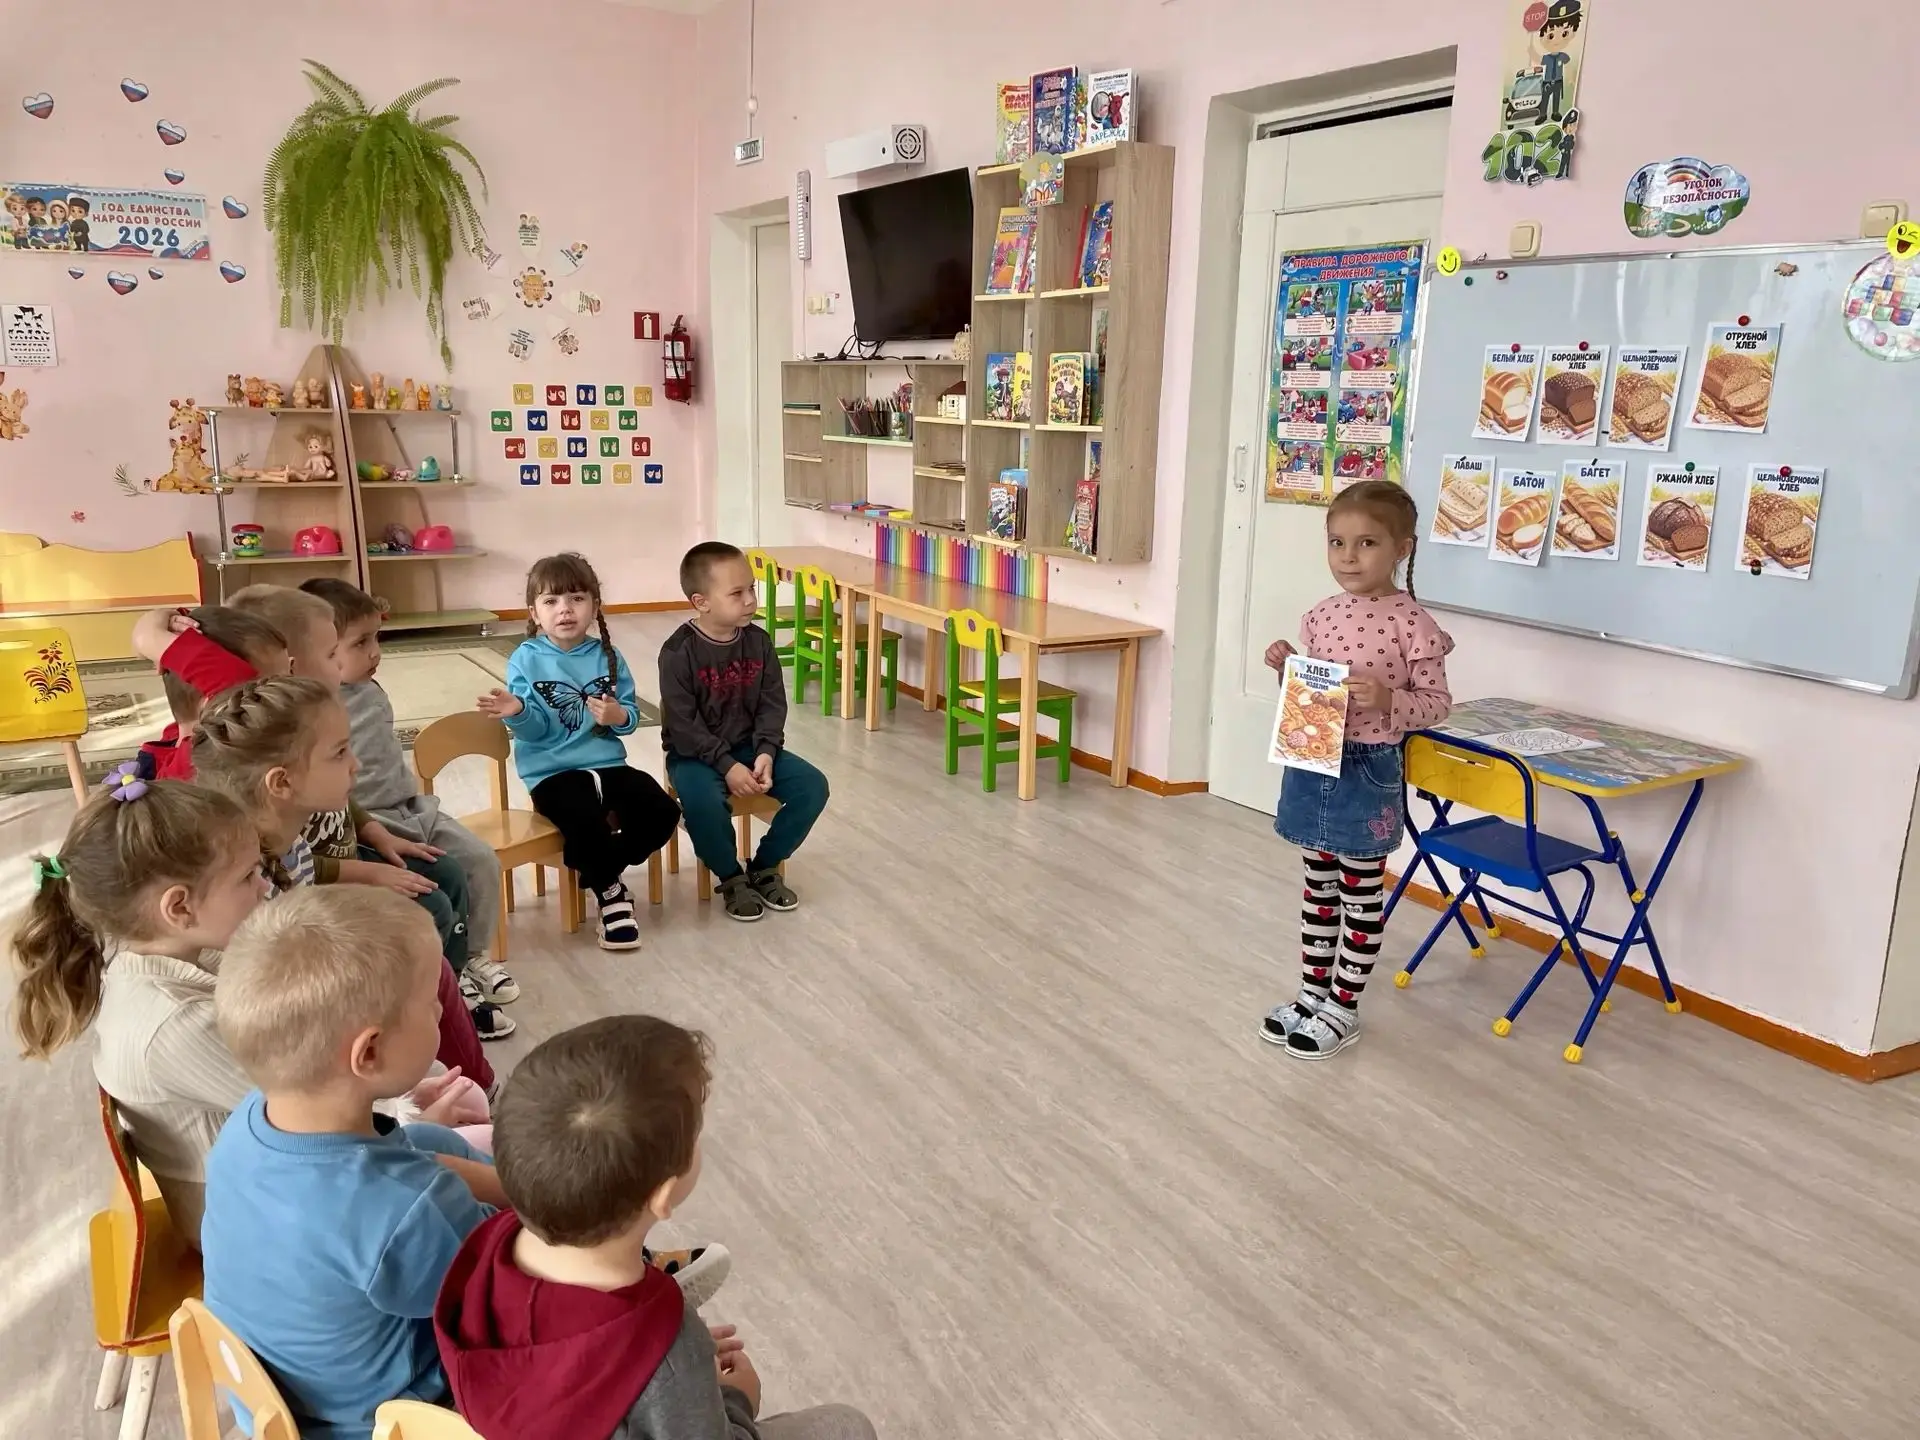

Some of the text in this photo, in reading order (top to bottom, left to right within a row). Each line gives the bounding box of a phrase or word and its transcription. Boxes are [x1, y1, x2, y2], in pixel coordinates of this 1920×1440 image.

[1525, 11, 1546, 23] STOP
[1090, 128, 1126, 143] ВАРЕЖКА
[1481, 124, 1563, 182] 102
[1684, 177, 1722, 190] УГОЛОК
[1663, 189, 1741, 204] БЕЗОПАСНОСТИ
[100, 202, 191, 216] ГОД ЕДИНСТВА
[92, 214, 201, 228] НАРОДОВ РОССИИ
[118, 225, 180, 247] 2026
[1294, 250, 1409, 268] ПРАВИЛА ДОРОЖНОГО
[1319, 266, 1375, 281] ДВИЖЕНИЯ
[1725, 330, 1768, 341] ОТРУБНОЙ
[1735, 340, 1757, 350] ХЛЕБ
[1492, 352, 1535, 363] БЕЛЫЙ ХЛЕБ
[1551, 350, 1601, 362] БОРОДИНСКИЙ
[1622, 353, 1678, 364] ЦЕЛЬНОЗЕРНОВОЙ
[1568, 361, 1587, 370] ХЛЕБ
[1640, 362, 1660, 371] ХЛЕБ
[1453, 460, 1482, 471] ЛАВАШ
[1580, 467, 1611, 478] БАГЕТ
[1656, 472, 1715, 486] РЖАНОЙ ХЛЕБ
[1757, 472, 1820, 486] ЦЕЛЬНОЗЕРНОВОЙ
[1512, 475, 1546, 489] БАТОН
[1778, 482, 1800, 492] ХЛЕБ
[1306, 664, 1330, 678] ХЛЕБ
[1306, 680, 1329, 691] ИЗДЕЛИЯ
